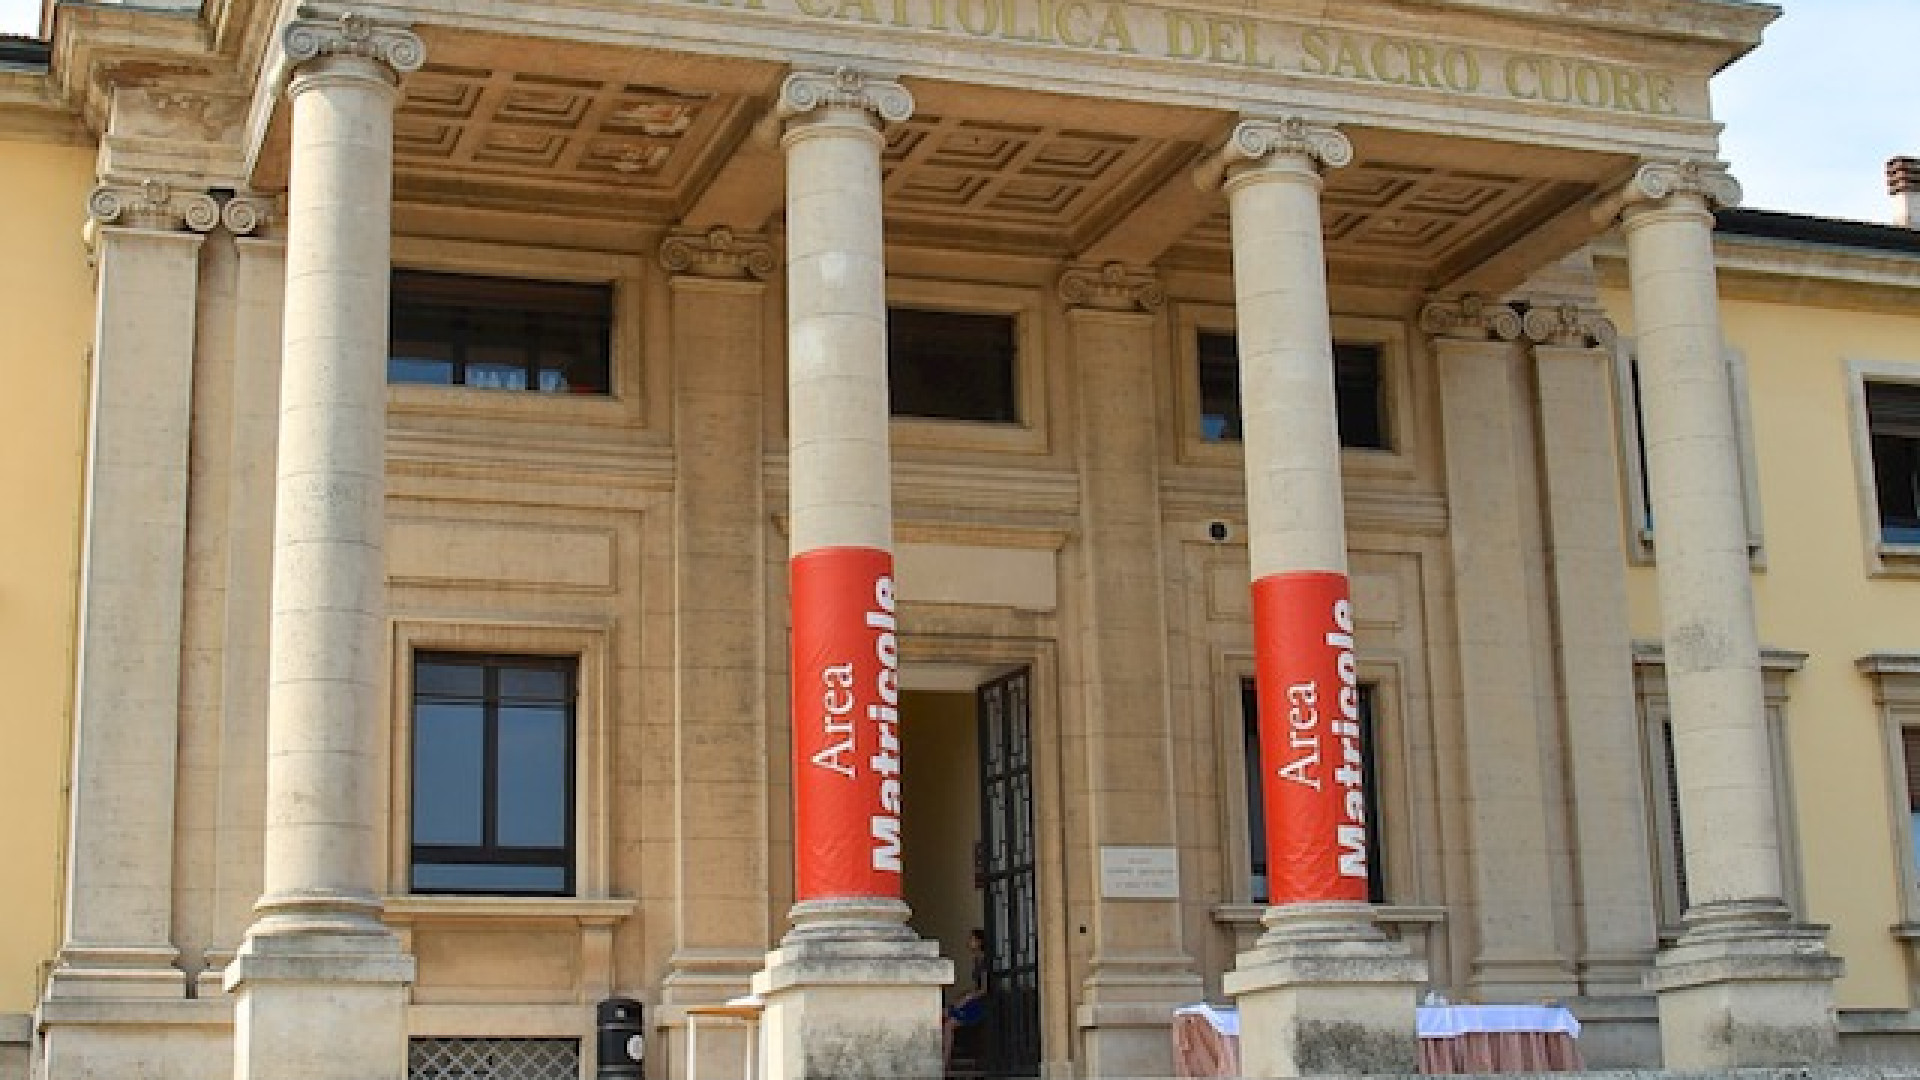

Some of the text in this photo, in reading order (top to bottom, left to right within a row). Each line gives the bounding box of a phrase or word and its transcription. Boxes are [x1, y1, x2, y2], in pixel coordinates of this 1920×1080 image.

[1164, 9, 1275, 69] DEL
[1301, 26, 1480, 93] SACRO
[1505, 52, 1678, 115] CUORE
[811, 663, 856, 779] Area
[865, 576, 902, 872] Matricole
[1277, 681, 1321, 792] Area
[1324, 599, 1368, 878] Matricole
